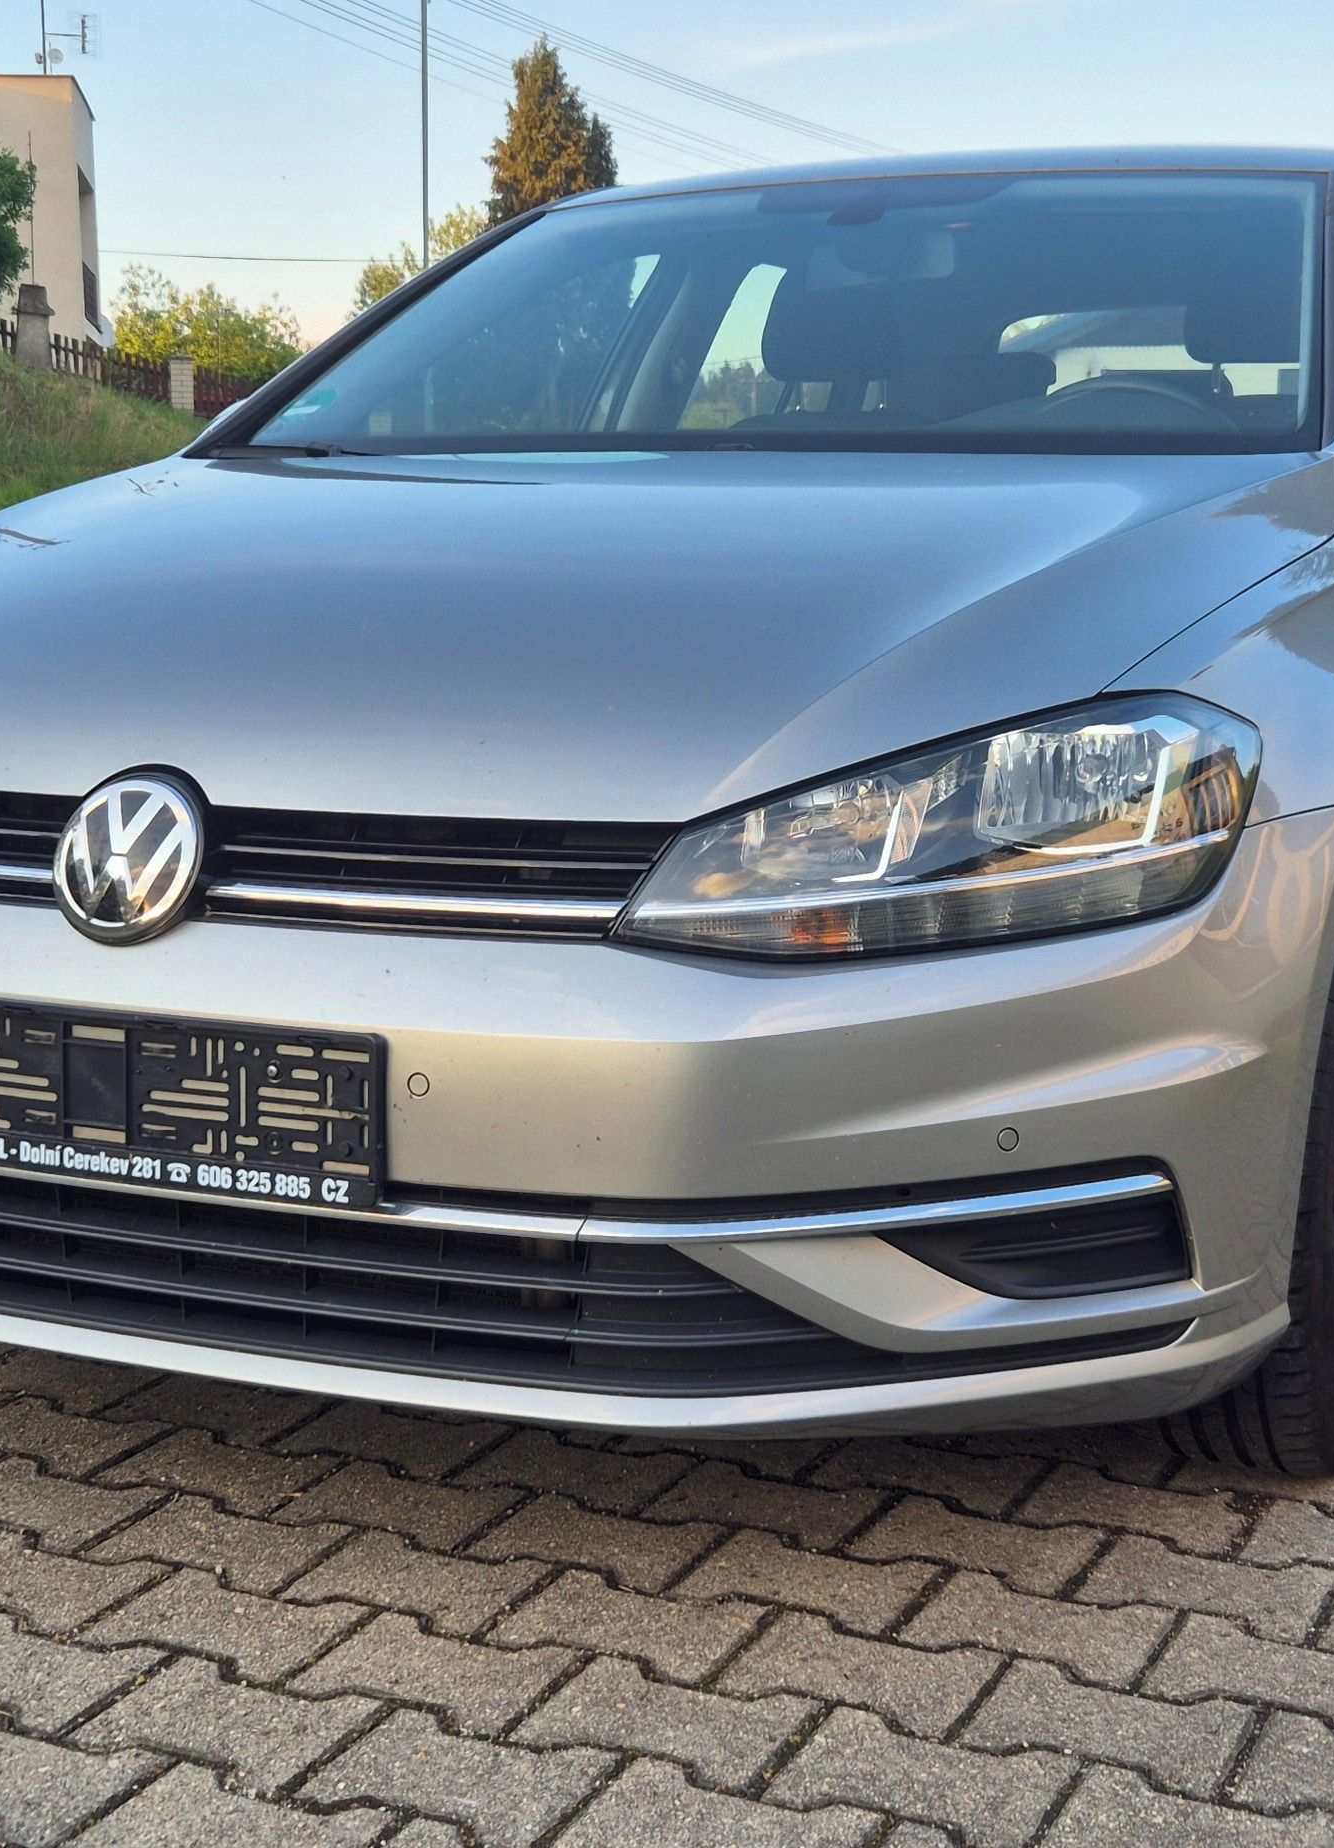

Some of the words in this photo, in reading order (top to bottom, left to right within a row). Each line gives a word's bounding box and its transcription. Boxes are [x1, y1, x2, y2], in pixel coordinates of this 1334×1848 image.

[57, 780, 197, 932] VW
[19, 1140, 63, 1167] Dolní
[63, 1146, 130, 1176] Cerekev
[131, 1156, 161, 1180] 281
[197, 1164, 233, 1190] 606
[235, 1169, 272, 1194] 325
[275, 1173, 311, 1199] 885
[321, 1177, 350, 1204] CZ
